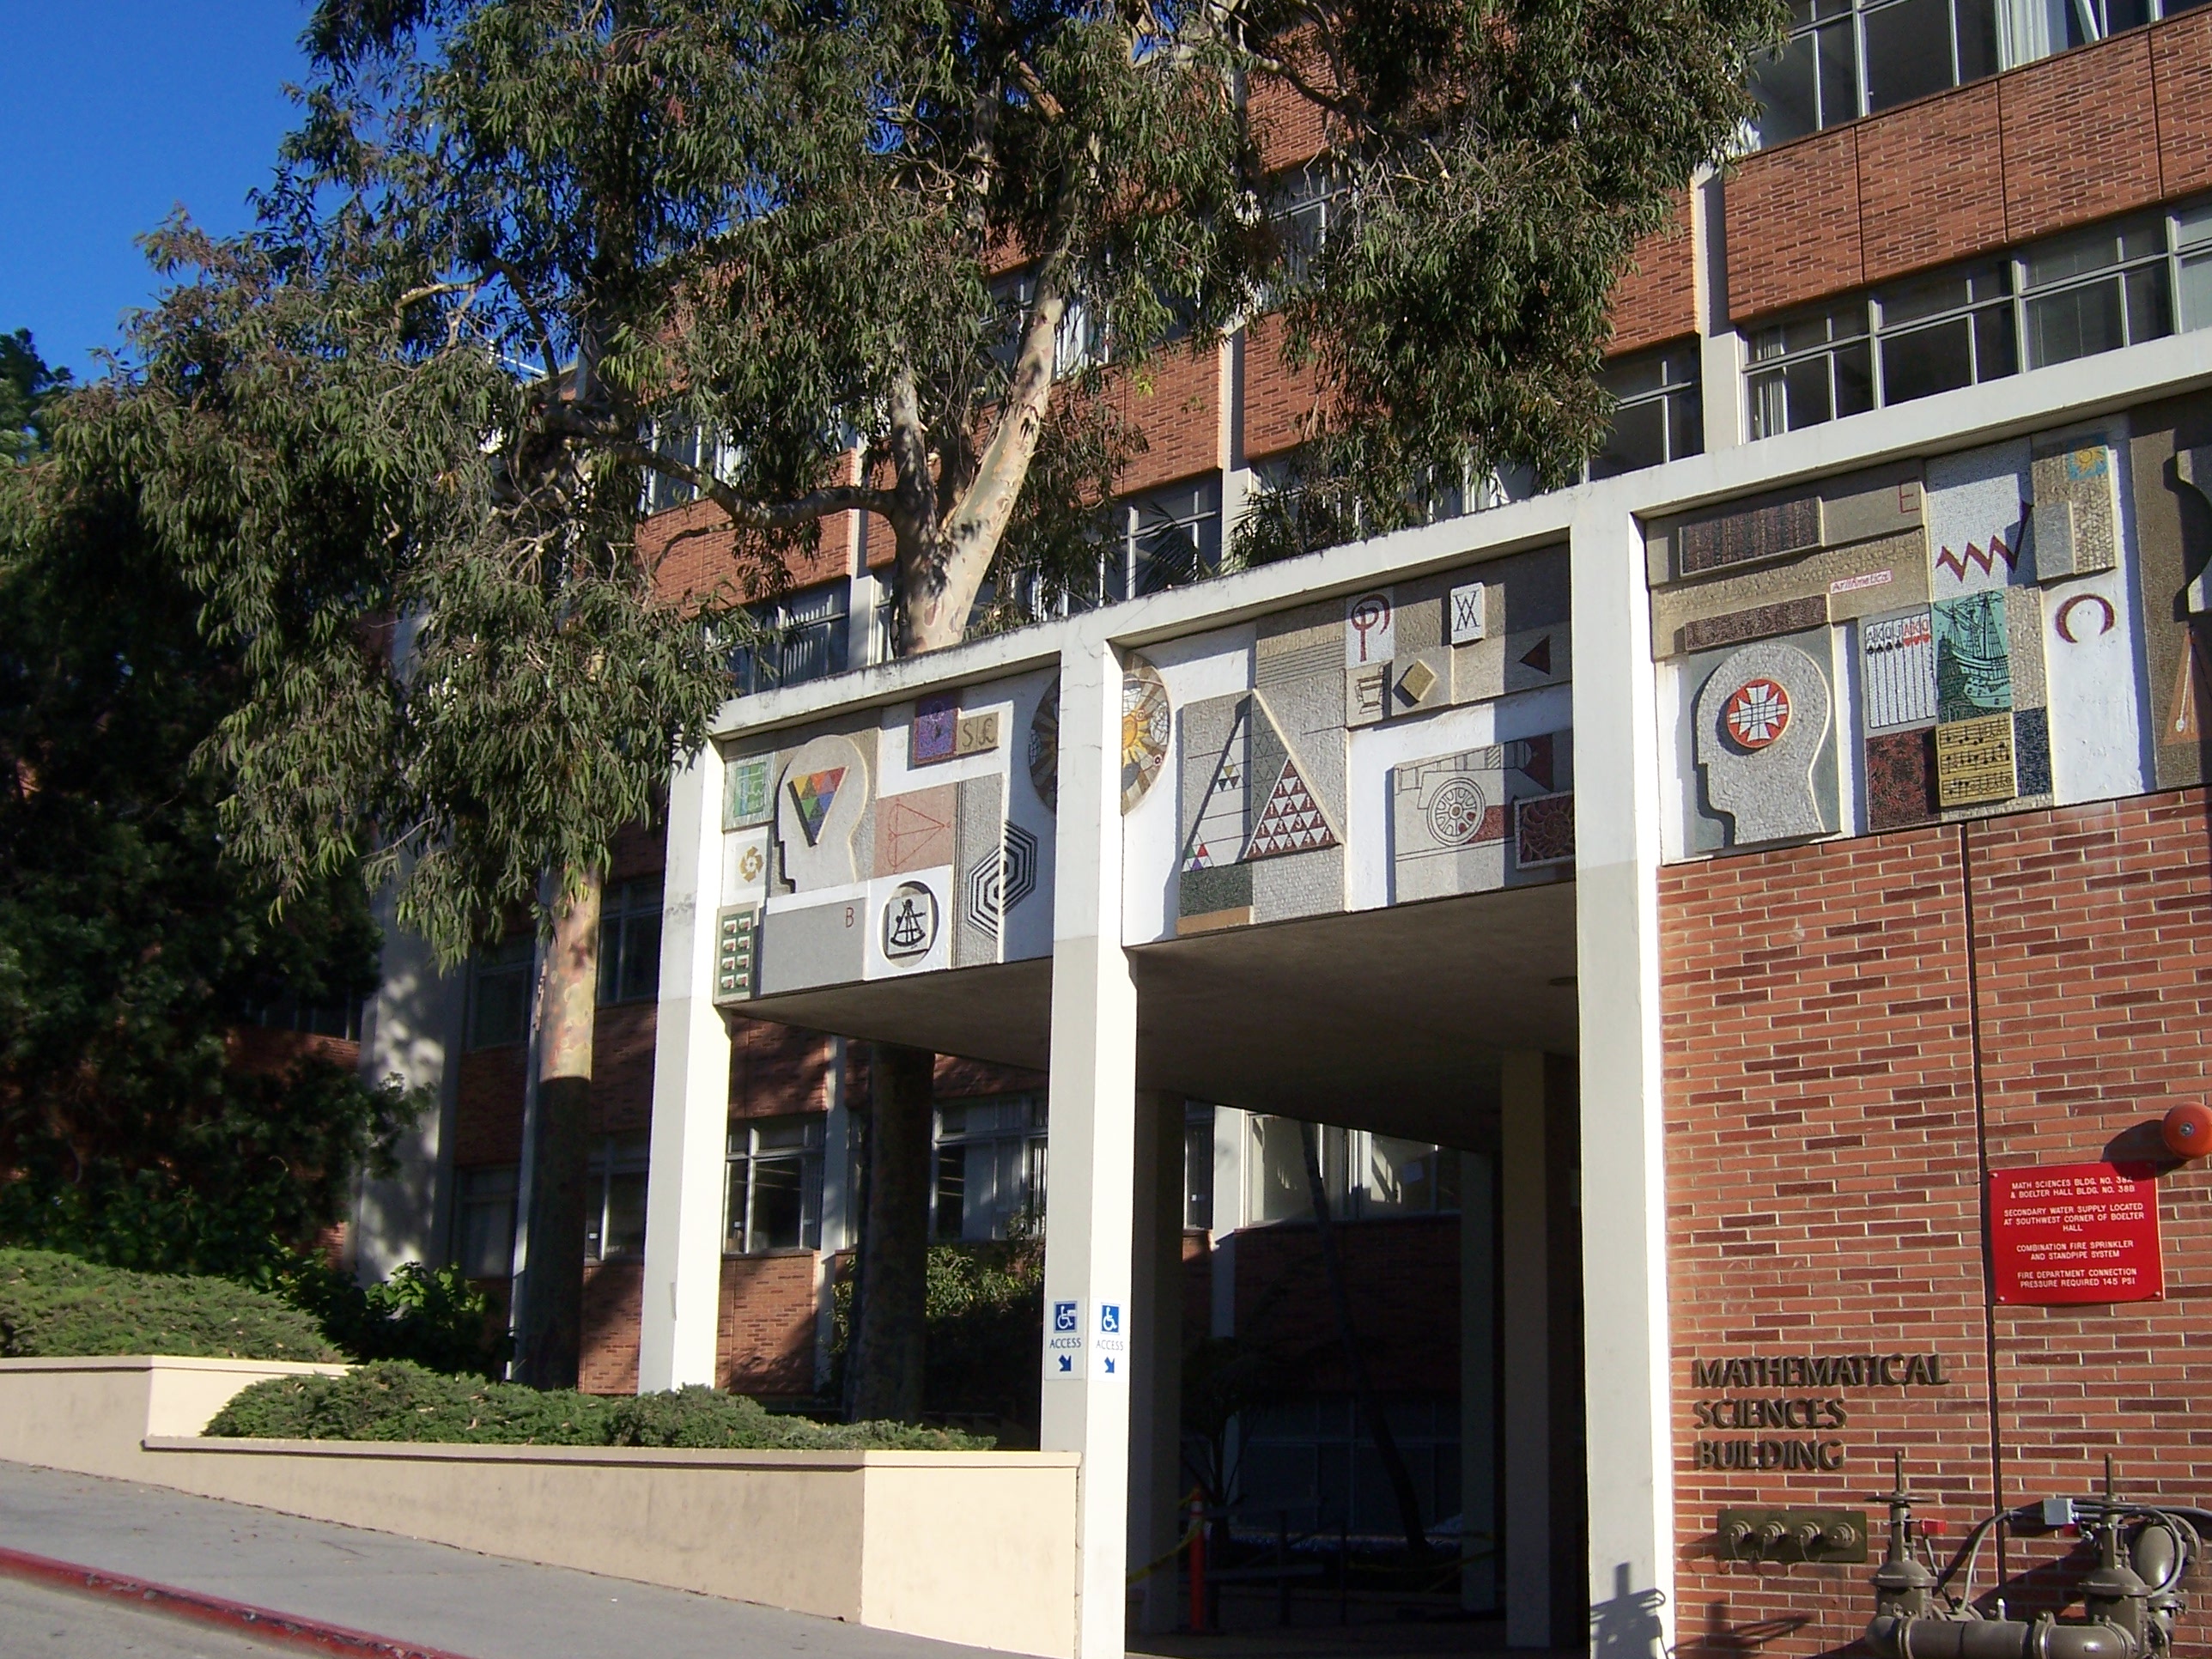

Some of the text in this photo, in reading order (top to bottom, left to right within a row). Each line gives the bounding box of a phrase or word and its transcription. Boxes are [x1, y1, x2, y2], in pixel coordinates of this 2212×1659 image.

[1904, 623, 1911, 636] A
[1911, 621, 1920, 635] K
[1285, 799, 1292, 812] 2
[1277, 819, 1284, 832] 3
[1295, 817, 1302, 829] 3
[845, 906, 855, 928] B
[2011, 1182, 2033, 1190] MATH
[2034, 1179, 2071, 1188] SCIENCES
[2074, 1177, 2097, 1187] BLDG.
[2100, 1176, 2112, 1185] NO.
[2009, 1191, 2016, 1200] &
[2018, 1189, 2051, 1199] BOELTER
[2053, 1188, 2073, 1196] HALL
[2076, 1187, 2100, 1195] BLDG.
[2101, 1186, 2115, 1194] NO.
[2003, 1202, 2144, 1218] SECONDARY WATER SUPPLY LOCATED
[2003, 1218, 2013, 1226] AT
[2015, 1215, 2060, 1225] SOUTHWEST
[2063, 1214, 2094, 1224] CORNER
[2111, 1211, 2145, 1221] BOELTER
[2063, 1224, 2083, 1232] HALL
[2016, 1239, 2134, 1253] COMBINATION FIRE SPRINKLER
[2030, 1249, 2120, 1261] AND STANDPIPE SYSTEM
[2017, 1267, 2137, 1279] FIRE DEPARTMENT CONNECTION
[2020, 1276, 2136, 1288] PRESSURE REQUIRED 145 PSI
[1049, 1338, 1082, 1349] ACCESS
[1096, 1340, 1124, 1351] ACCESS
[1694, 1353, 1952, 1388] MATHEMATICAL
[1693, 1397, 1848, 1429] SCIENCES
[1694, 1438, 1844, 1470] BUILDING
